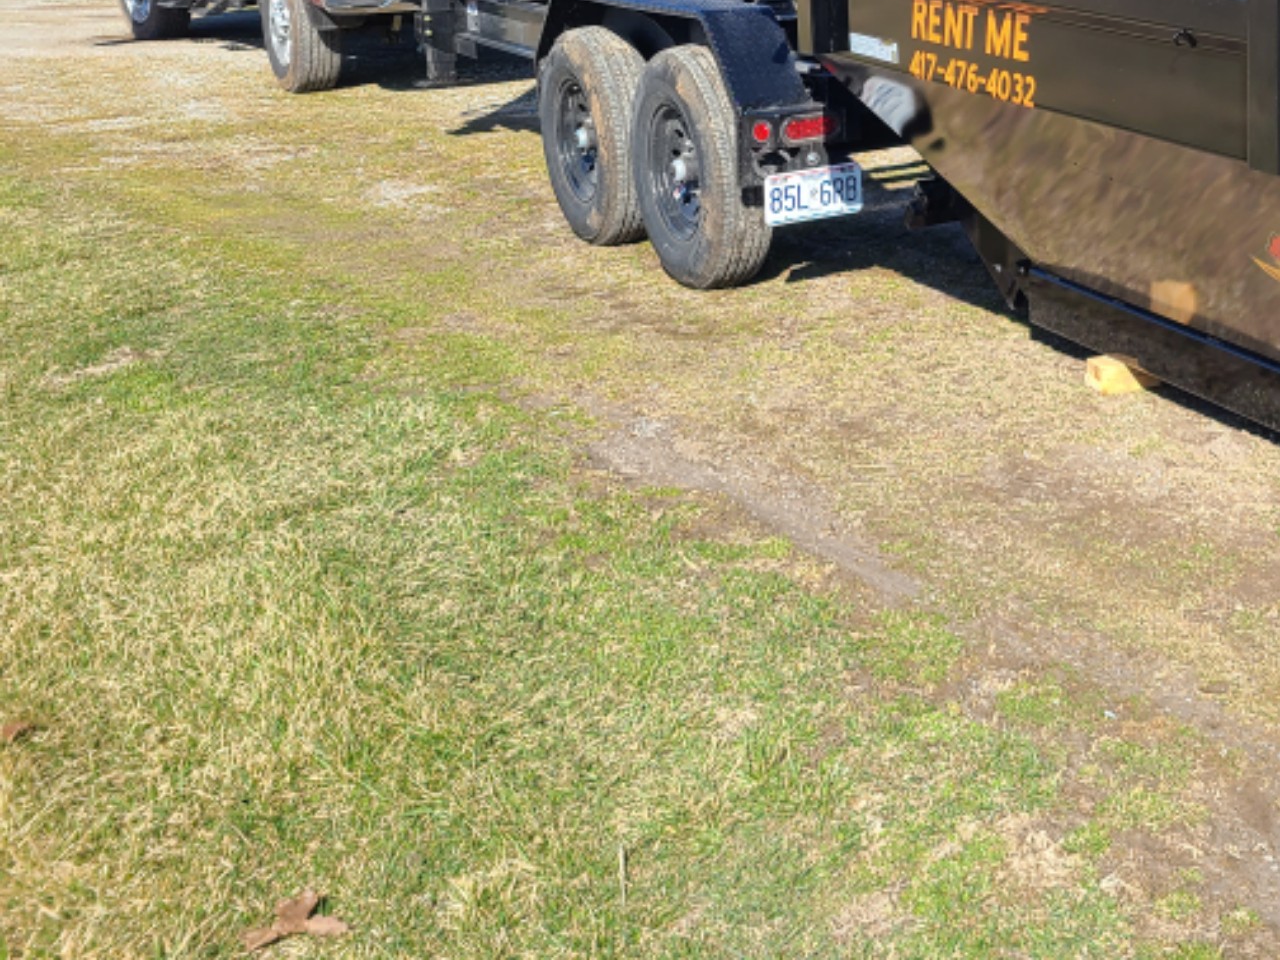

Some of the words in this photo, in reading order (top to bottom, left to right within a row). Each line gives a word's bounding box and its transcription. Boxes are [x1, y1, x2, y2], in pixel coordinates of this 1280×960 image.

[985, 8, 1031, 62] ME
[909, 50, 1036, 108] 417-476-4032
[769, 184, 809, 214] 85L
